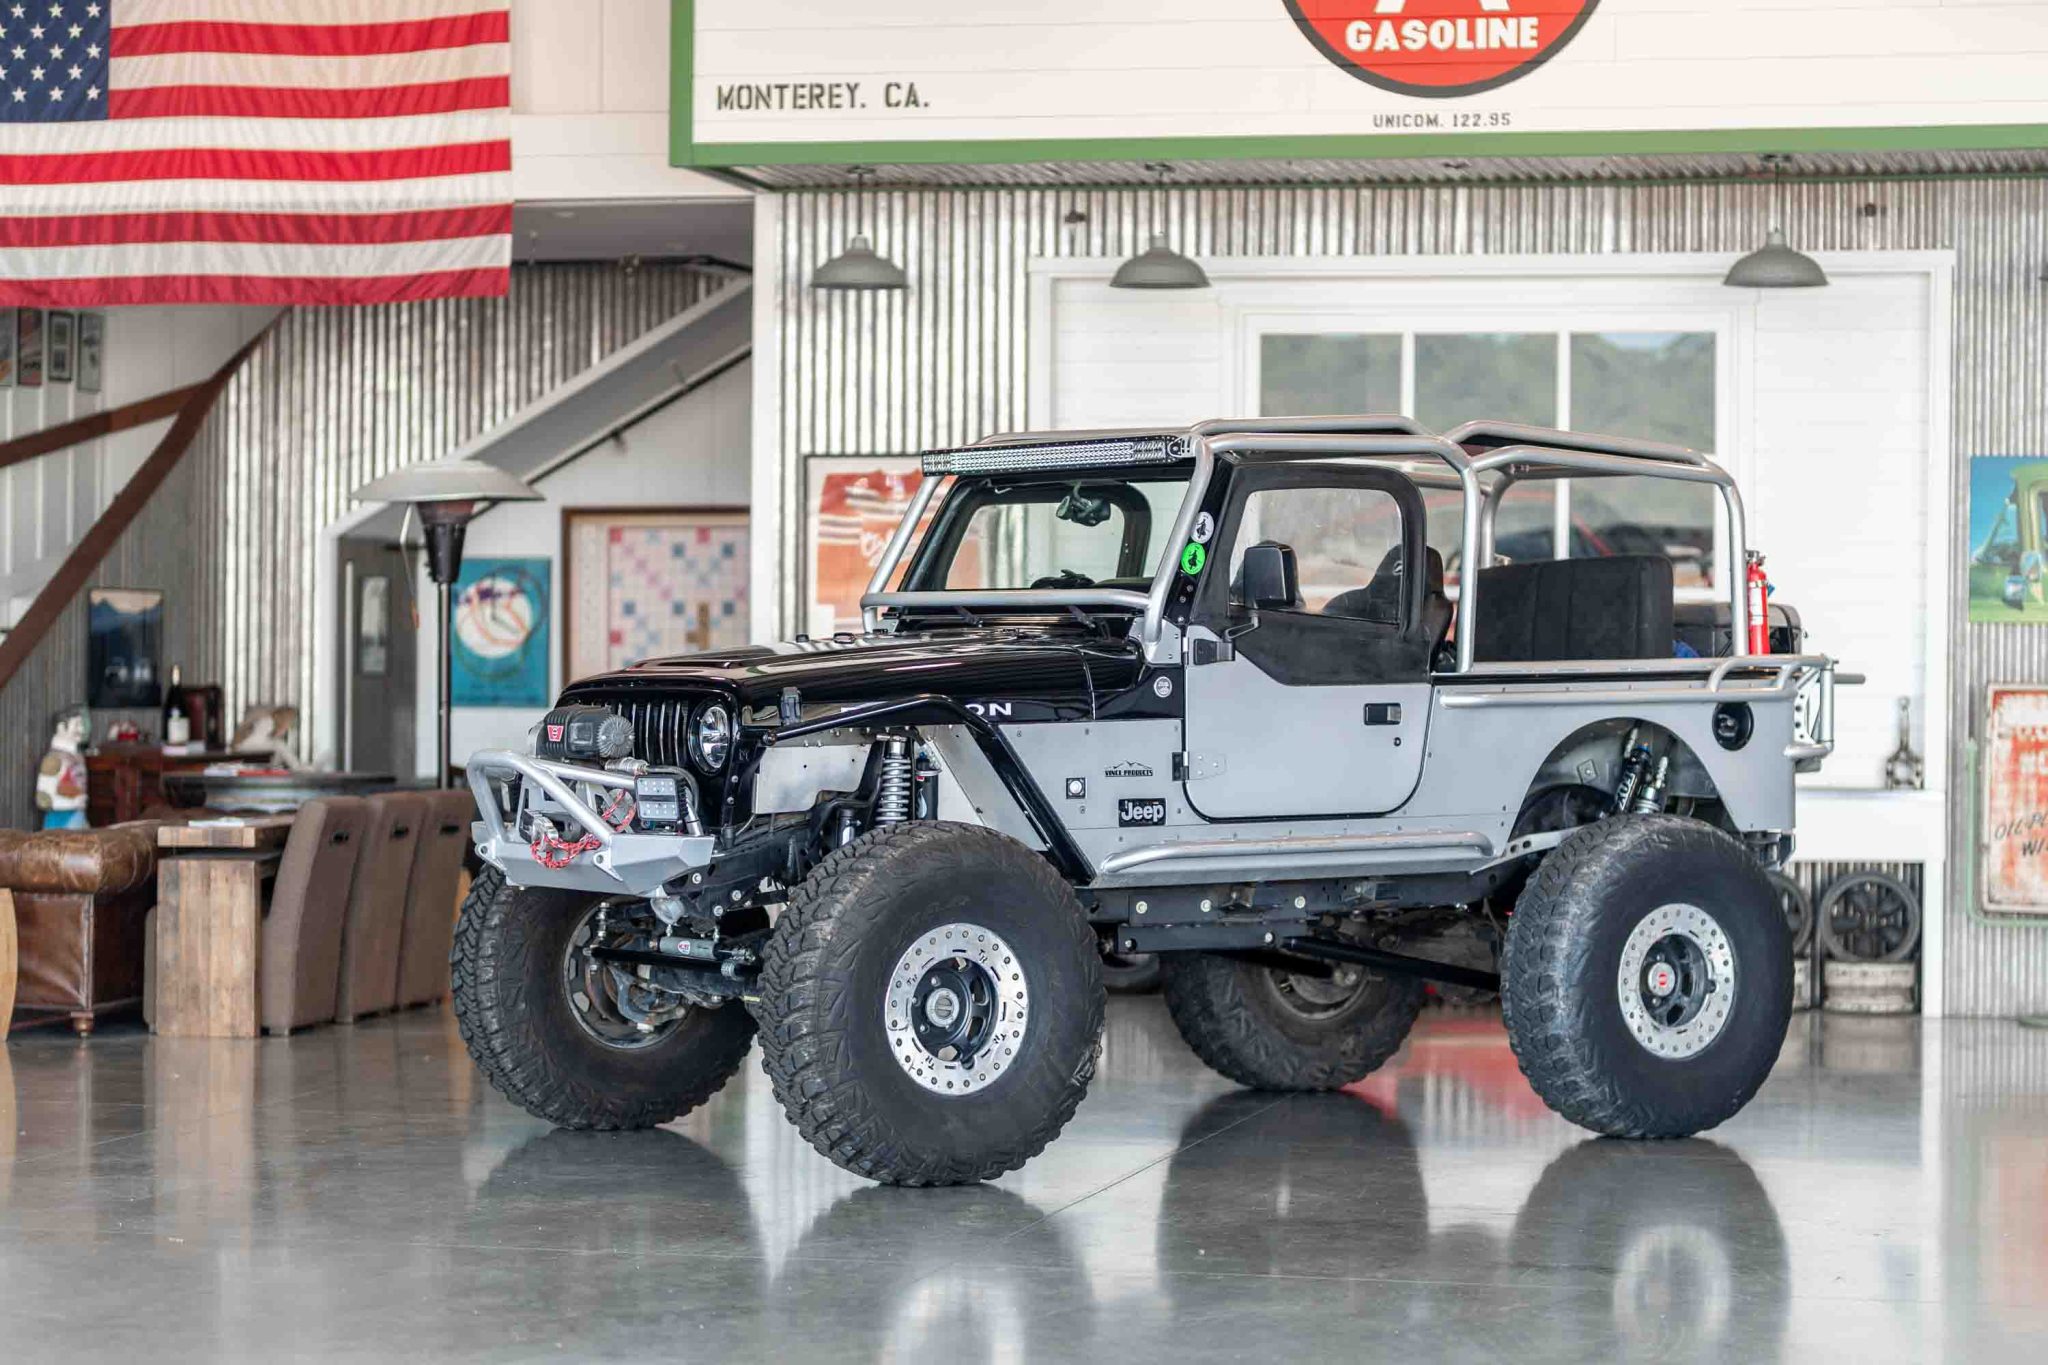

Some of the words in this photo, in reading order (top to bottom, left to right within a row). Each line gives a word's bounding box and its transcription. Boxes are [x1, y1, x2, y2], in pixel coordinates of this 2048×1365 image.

[1345, 16, 1539, 52] GASOLINE
[884, 82, 930, 109] CA.
[1453, 112, 1511, 128] 122.95
[1121, 801, 1165, 822] Jeep
